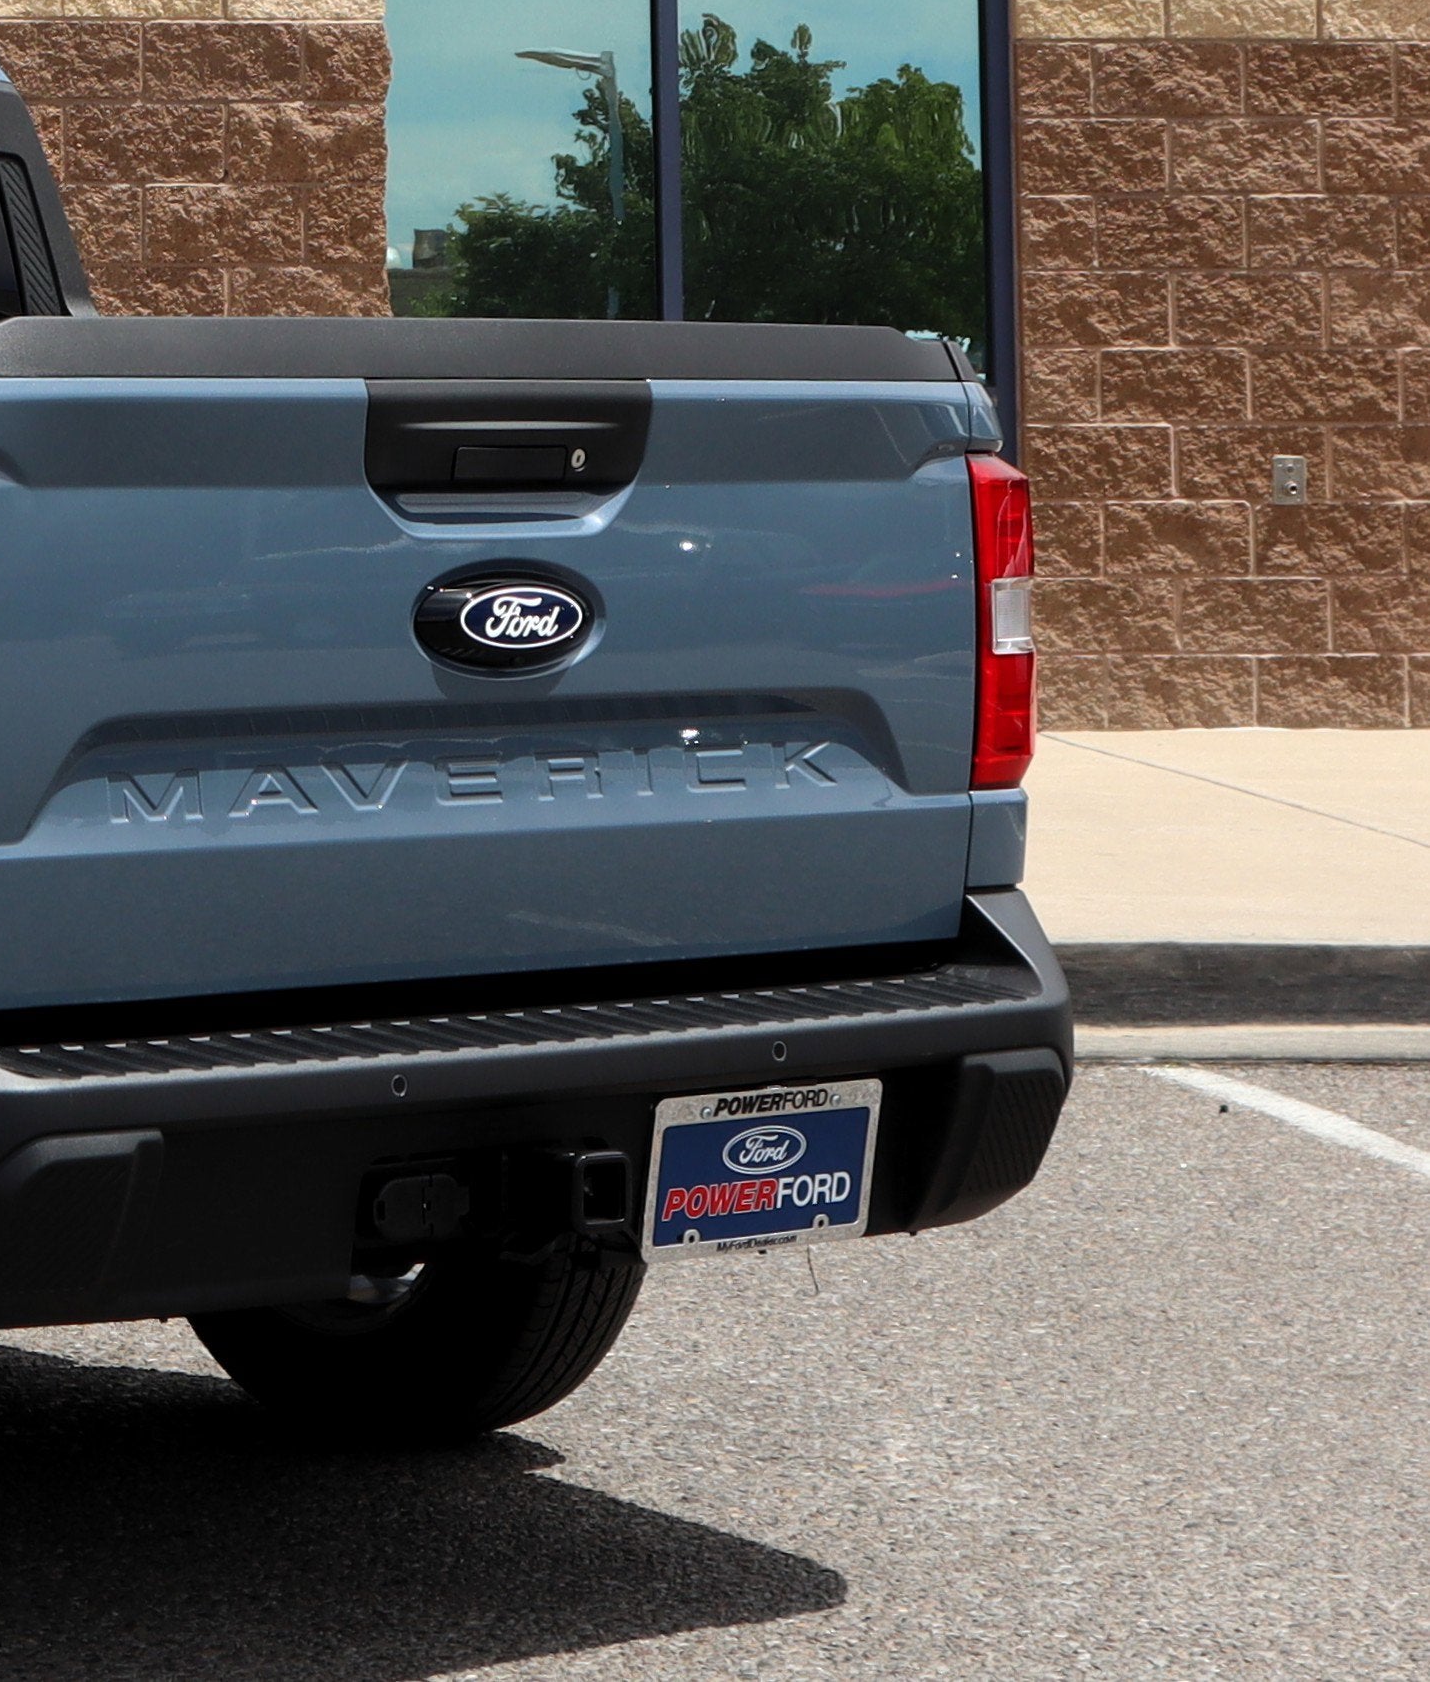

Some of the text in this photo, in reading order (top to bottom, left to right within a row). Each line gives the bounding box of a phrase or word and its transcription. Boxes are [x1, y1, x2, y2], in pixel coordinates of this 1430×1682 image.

[485, 595, 560, 639] Ford
[105, 740, 838, 825] MAVERICK
[739, 1134, 790, 1164] Ford
